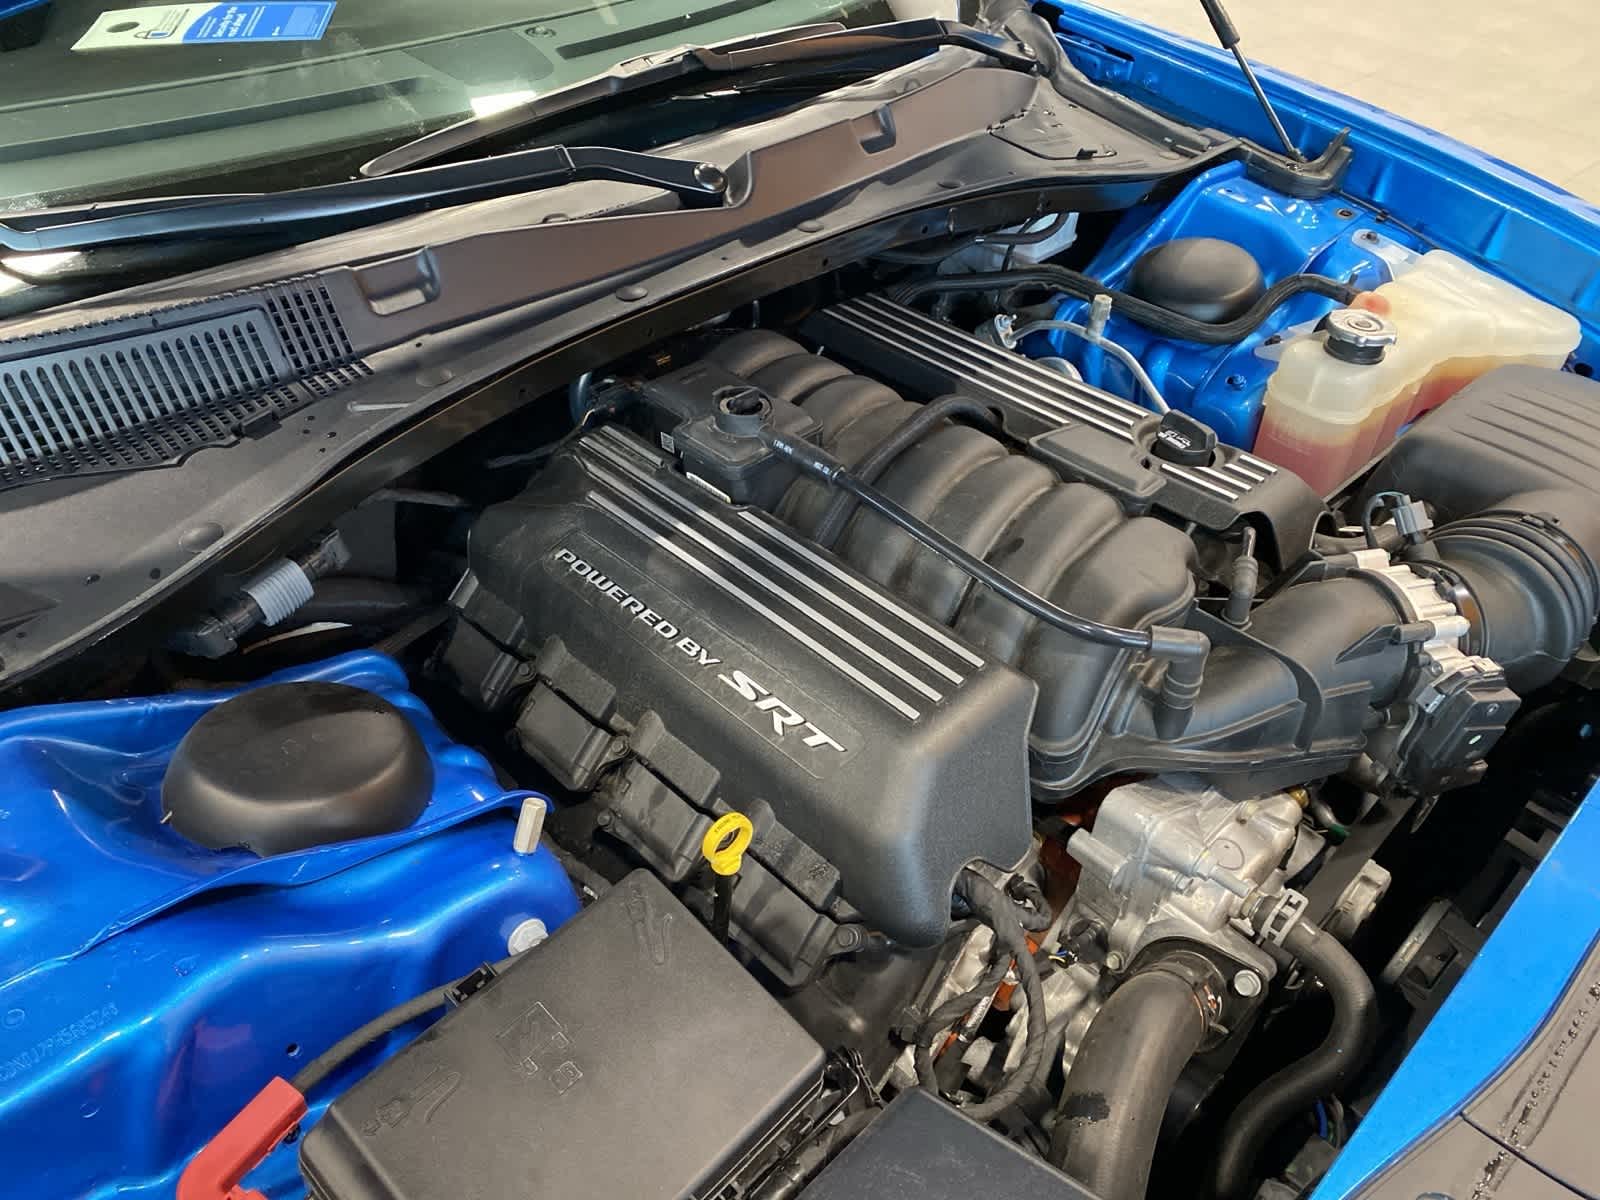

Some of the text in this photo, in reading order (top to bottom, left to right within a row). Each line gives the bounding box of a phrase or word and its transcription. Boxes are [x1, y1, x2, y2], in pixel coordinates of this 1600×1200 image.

[555, 548, 848, 752] POWERED BY SRT
